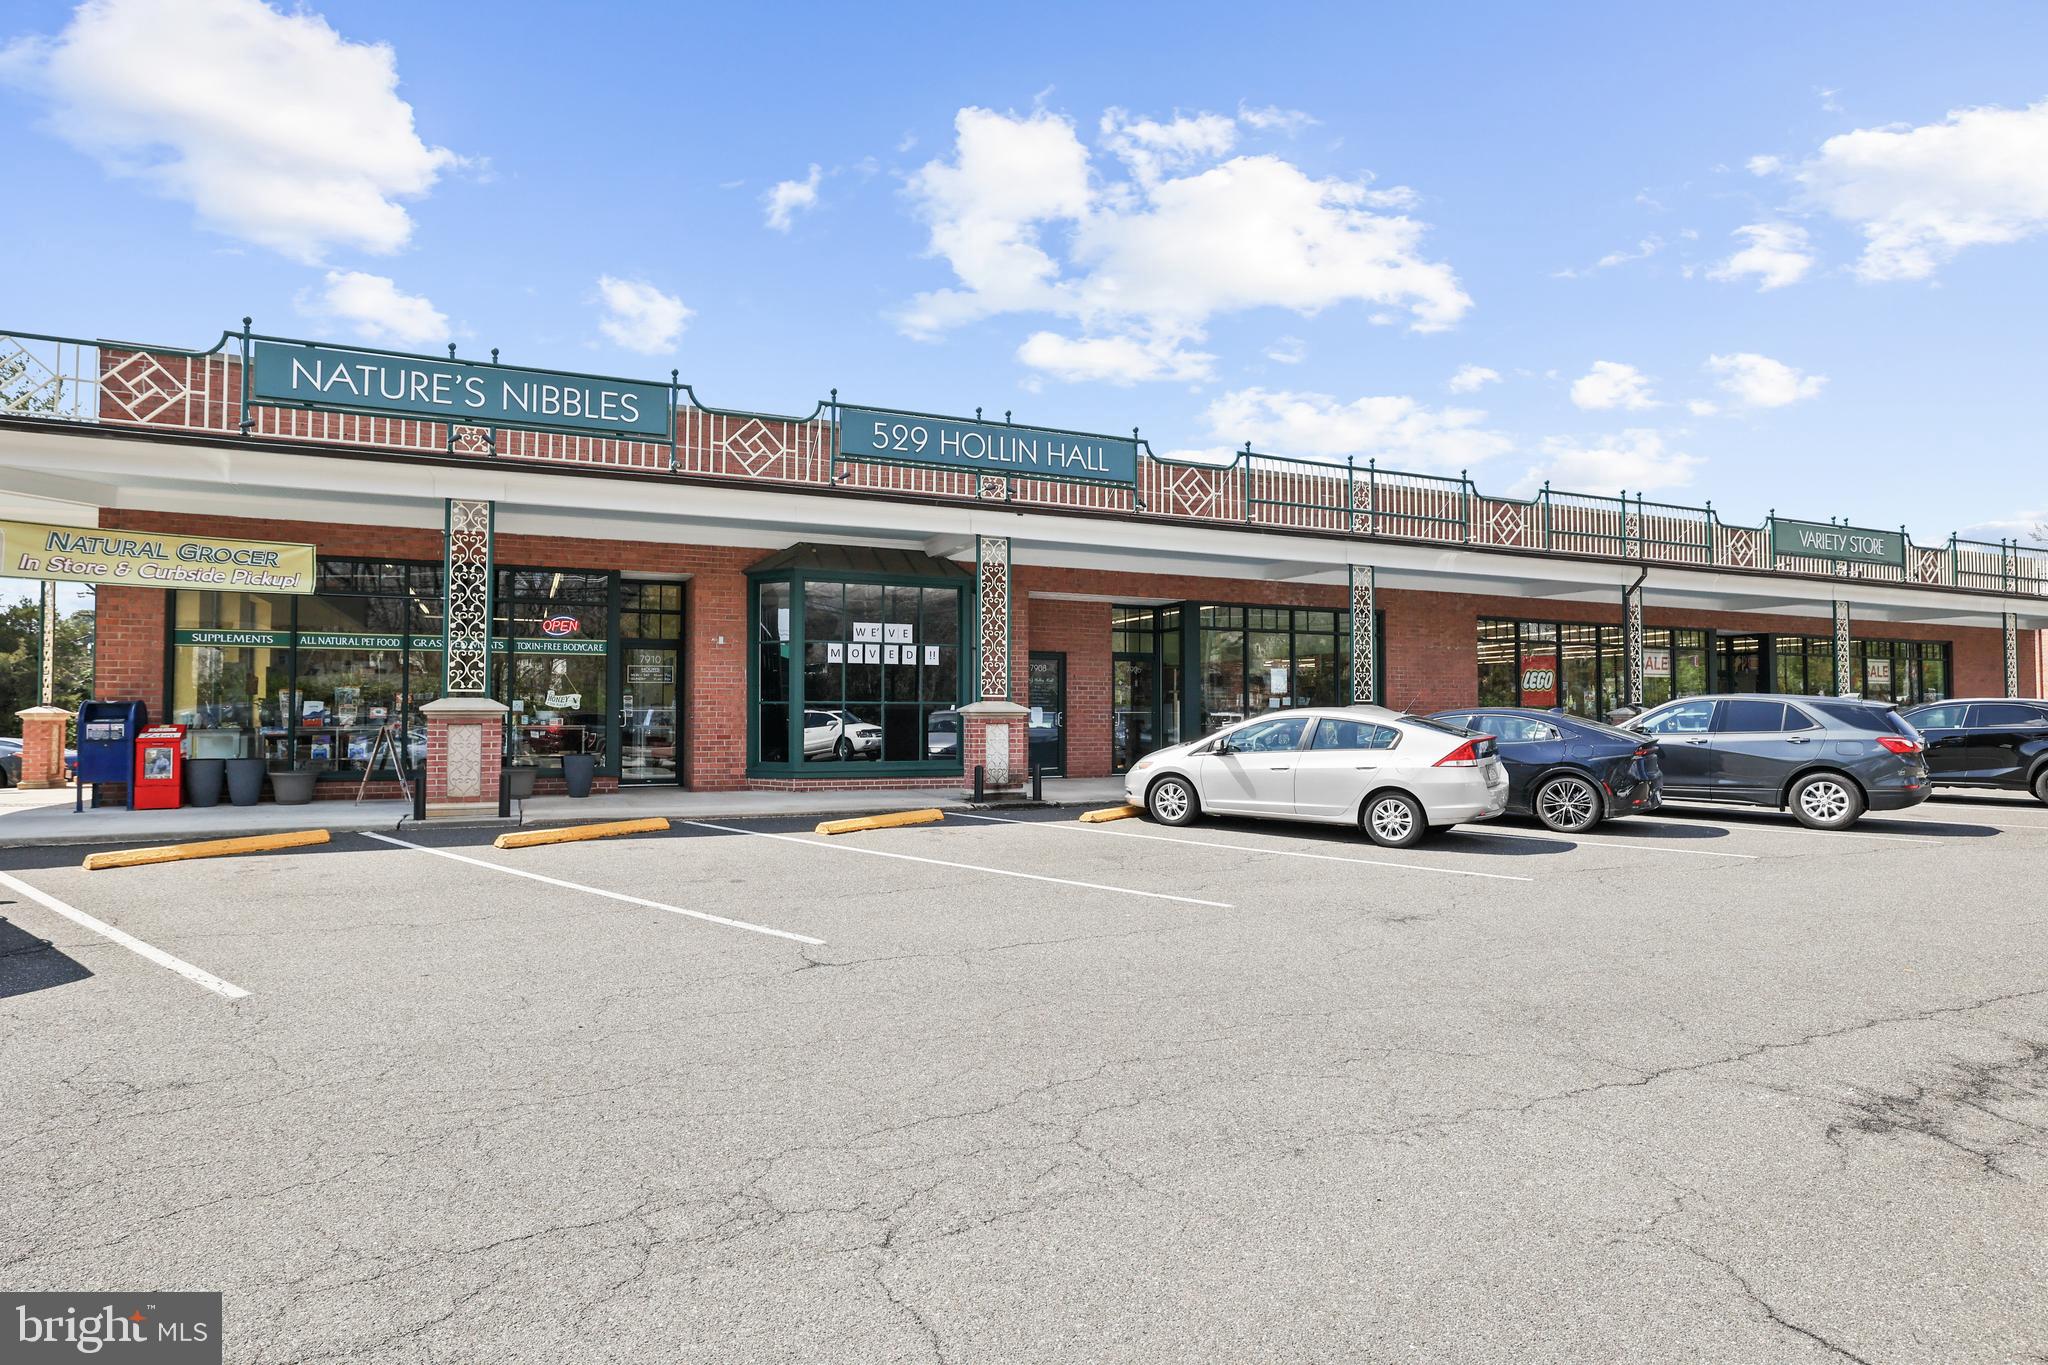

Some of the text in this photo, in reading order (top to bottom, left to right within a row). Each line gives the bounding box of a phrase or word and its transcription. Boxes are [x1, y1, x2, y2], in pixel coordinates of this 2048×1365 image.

[292, 357, 640, 424] NATURE'S NIBBLES
[872, 422, 1110, 473] 529 HOLLIN HALL
[45, 529, 280, 568] NATURAL GROCER
[1798, 529, 1885, 556] VARIETY STORE
[17, 553, 302, 589] In Store & Curbside Pickup!
[542, 619, 580, 632] OPEN
[191, 633, 274, 644] SUPPLEMENTS
[299, 636, 401, 647] ALL NATURAL PET FOOD
[516, 641, 604, 652] TOXIN-FREE BODYCARE
[639, 654, 662, 664] 7910
[830, 648, 914, 660] MOVED
[1644, 657, 1669, 671] ALE
[1522, 670, 1554, 690] LEGO
